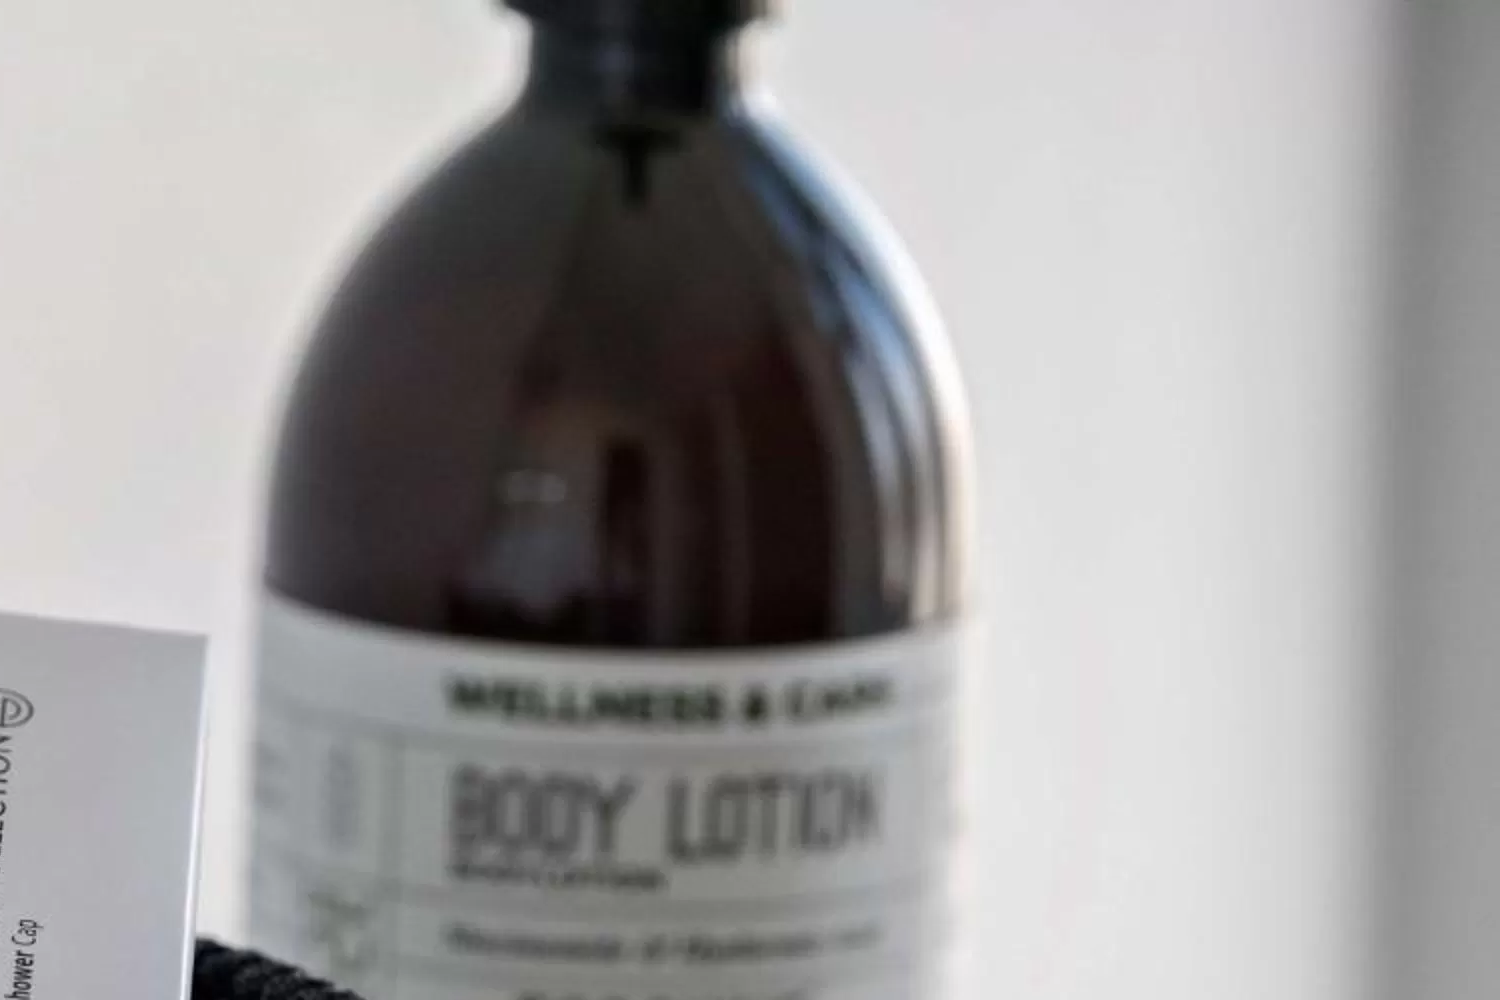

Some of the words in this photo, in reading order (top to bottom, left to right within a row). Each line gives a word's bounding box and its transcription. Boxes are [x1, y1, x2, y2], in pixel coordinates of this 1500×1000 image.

[450, 764, 640, 860] BODY
[665, 770, 882, 862] LOTION
[11, 919, 44, 947] Cap
